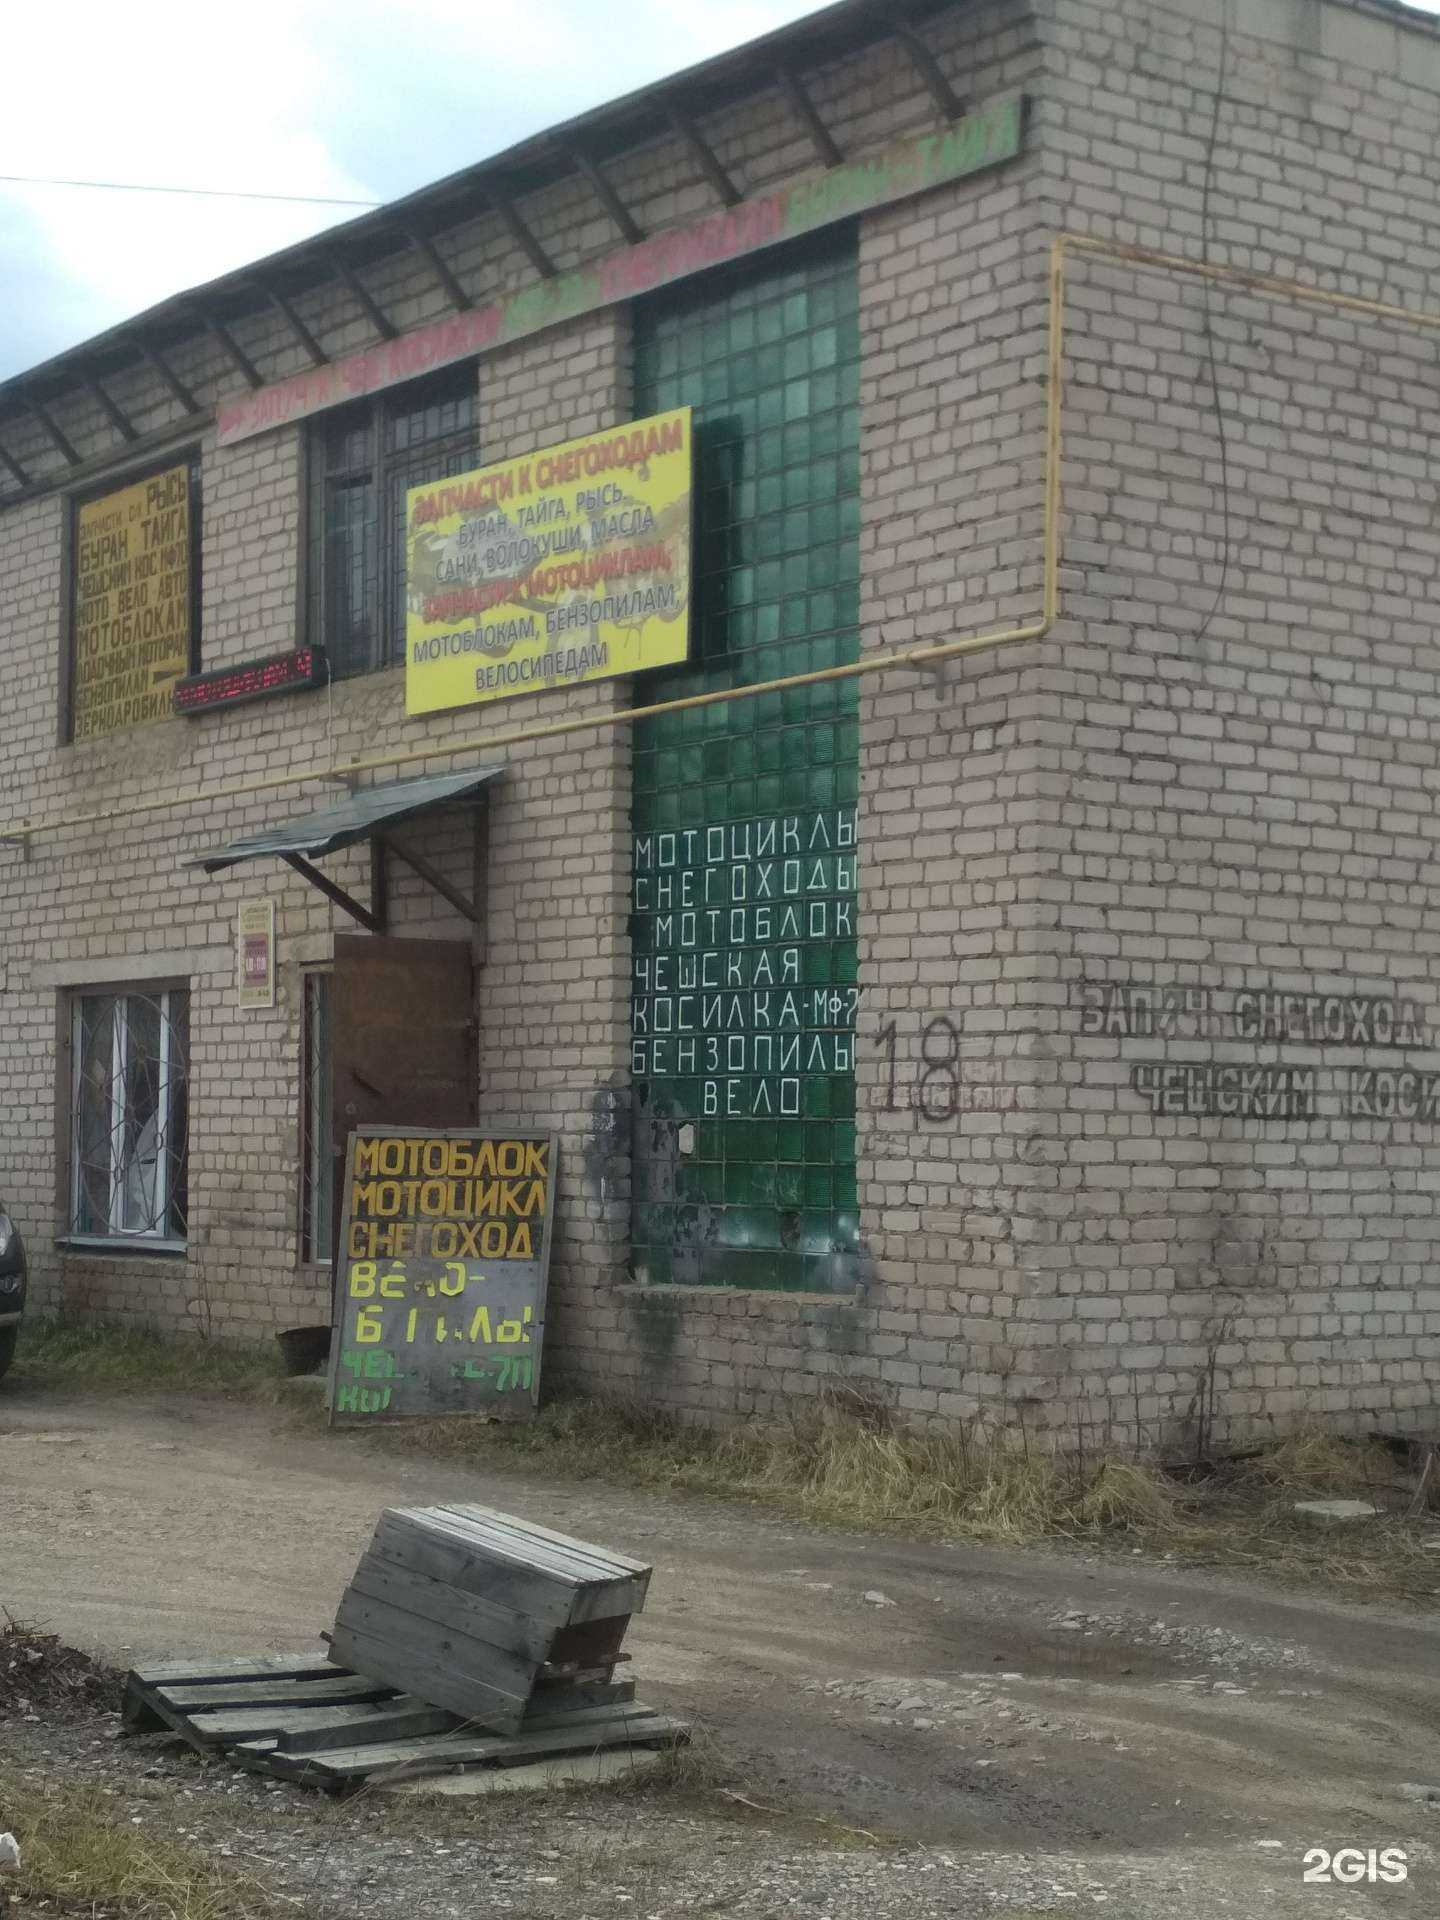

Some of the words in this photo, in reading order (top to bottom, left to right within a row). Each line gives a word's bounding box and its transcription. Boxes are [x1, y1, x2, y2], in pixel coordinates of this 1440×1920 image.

[518, 462, 533, 496] К
[536, 419, 683, 489] СНЕГОХОДАМ
[591, 505, 654, 540] МАСЛА
[80, 527, 128, 573] БУРАН
[474, 642, 609, 690] ВЕЛОСИПЕДАМ
[635, 808, 859, 869] МОТОЦИКЛЫ
[635, 855, 857, 910] СНЕГОХОДЫ
[656, 902, 851, 947] МОТОБЛОК
[635, 949, 799, 991] ЧЕШСКАЯ
[632, 1033, 856, 1074] БЕНЗОПИЛЫ
[874, 1015, 959, 1123] 18
[704, 1078, 799, 1115] ВЕЛО
[355, 1138, 549, 1178] МОТОБЛОК
[352, 1179, 545, 1217] МОТОЦИКЛ
[349, 1221, 534, 1260] СНЕГОХОД
